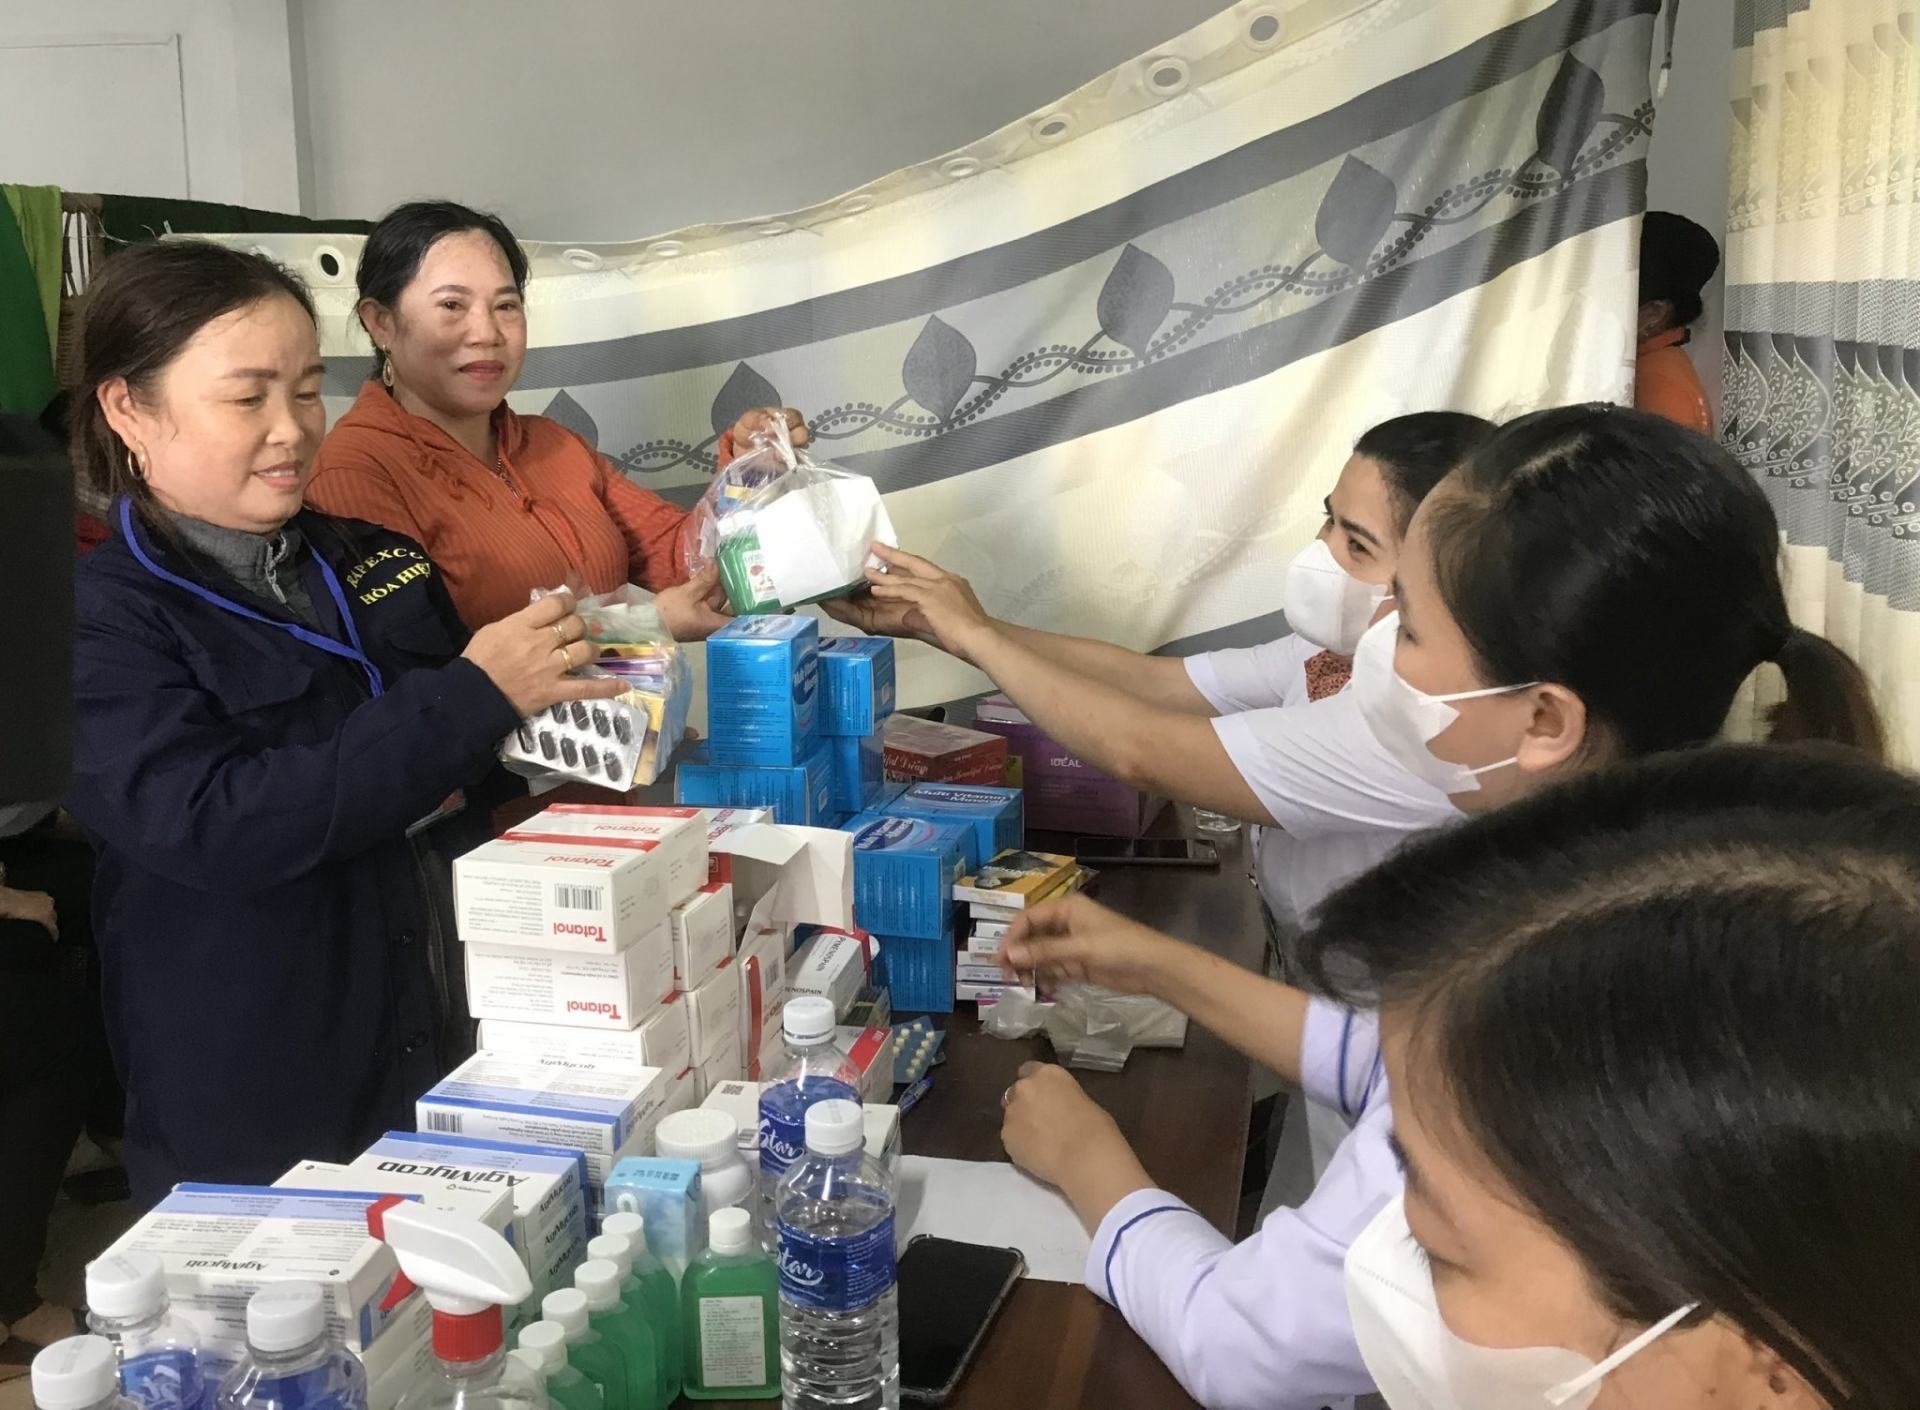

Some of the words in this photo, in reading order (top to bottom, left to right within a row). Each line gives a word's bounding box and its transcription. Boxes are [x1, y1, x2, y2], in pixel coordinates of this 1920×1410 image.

[1050, 757, 1082, 768] IDEAL
[913, 788, 951, 797] Multi
[594, 824, 661, 835] Tatanol
[543, 855, 616, 868] Tatanol
[553, 922, 607, 943] Tatanol
[567, 1000, 622, 1020] Tatanol
[184, 1258, 270, 1273] AgiMycob
